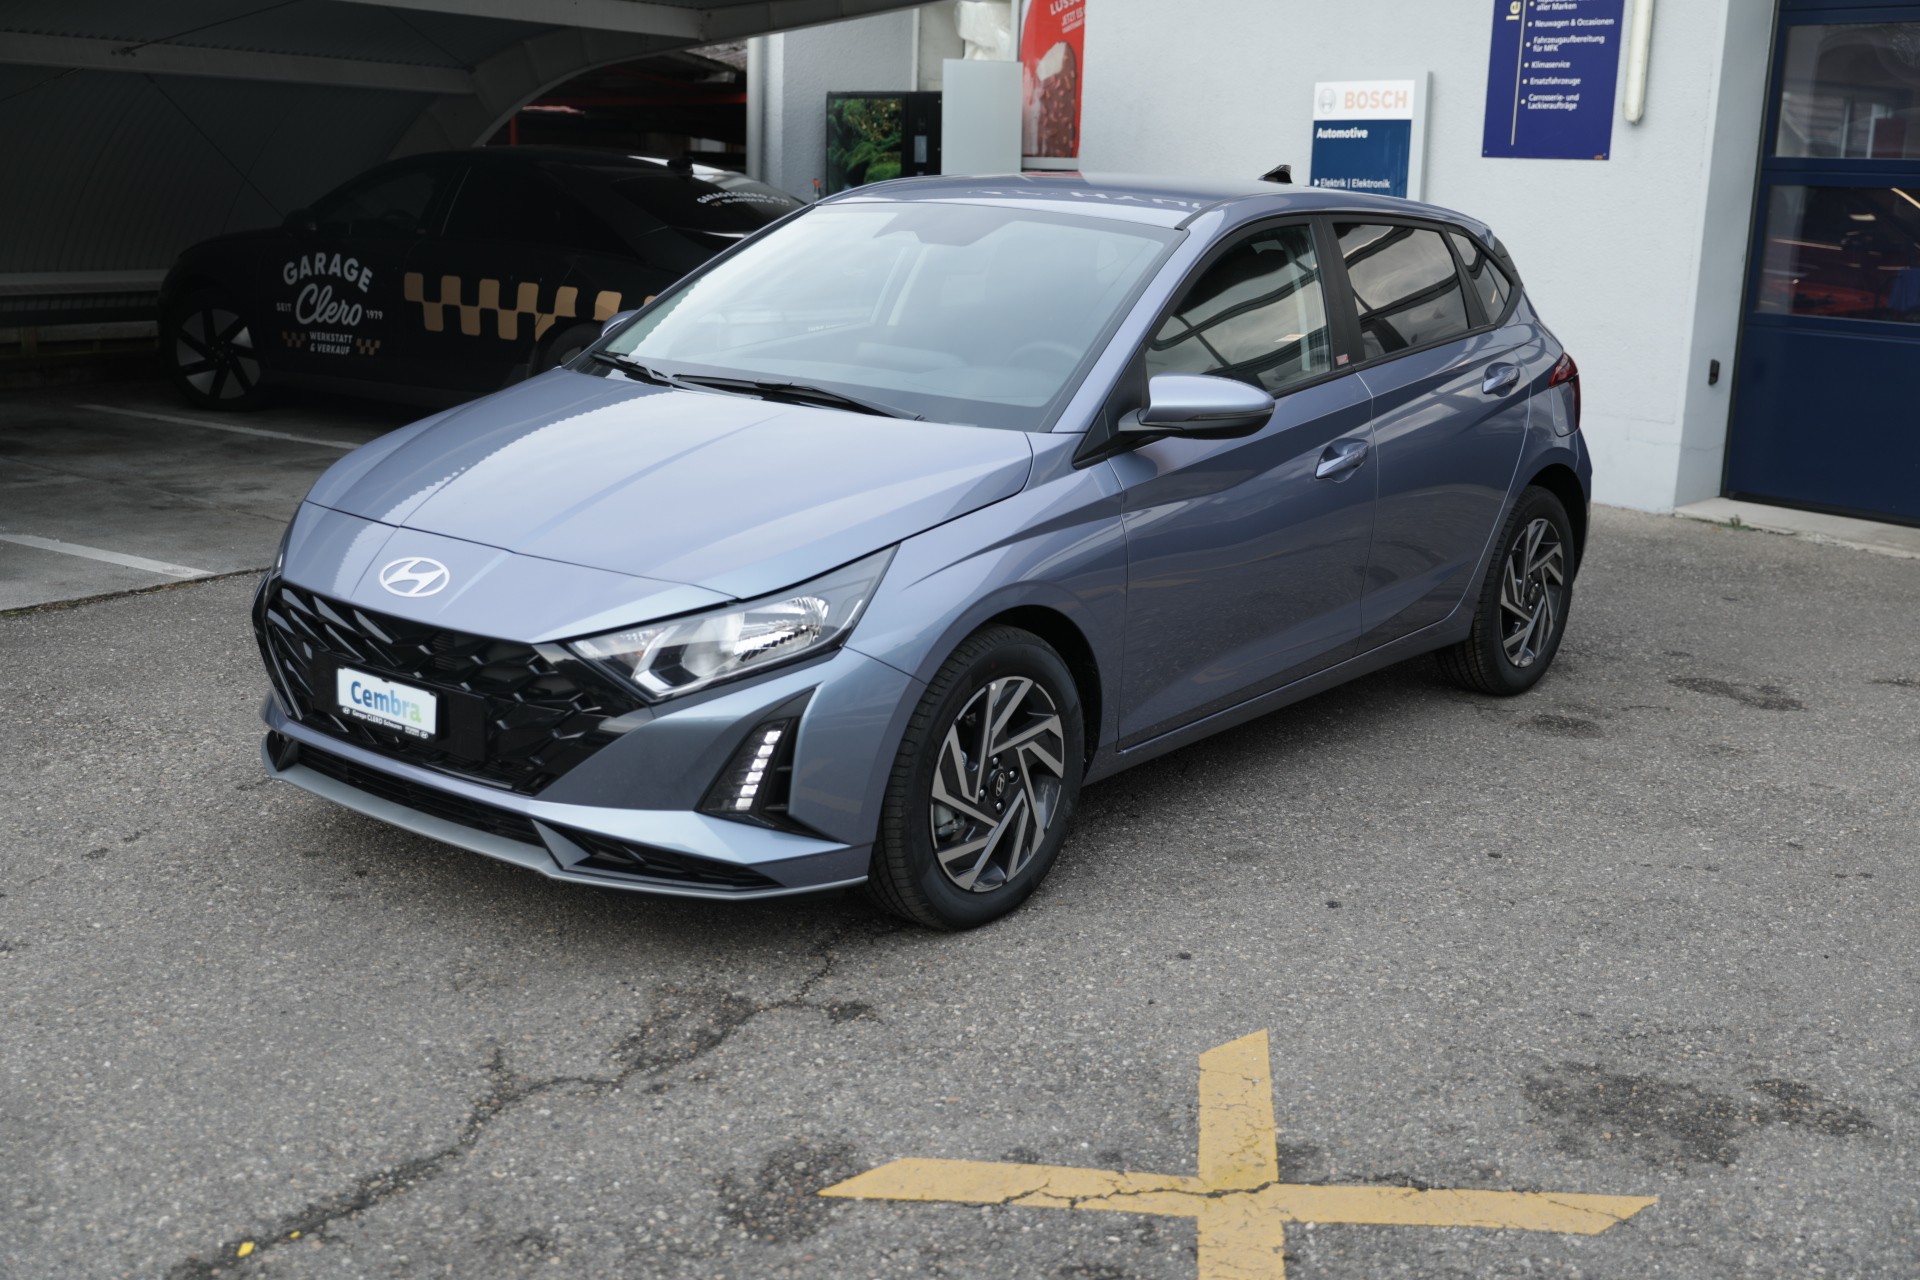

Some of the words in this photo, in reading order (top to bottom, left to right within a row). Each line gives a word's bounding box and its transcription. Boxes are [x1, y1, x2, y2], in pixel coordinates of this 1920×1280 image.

[1050, 0, 1081, 15] LUS
[1536, 3, 1551, 11] aller
[1552, 2, 1577, 10] Marken
[1535, 20, 1569, 28] Neuwagen
[1577, 18, 1614, 26] Occasionen
[1533, 35, 1605, 44] Fahrzeugaufbereitung
[1530, 77, 1581, 86] Ersatzfahrzeuge
[1344, 91, 1407, 109] BOSCH
[1566, 93, 1580, 101] und
[1528, 102, 1577, 111] Lackieraufträge
[1316, 127, 1368, 138] Automotive
[1320, 178, 1346, 188] Elektrik
[1351, 179, 1390, 188] Elektronik
[283, 252, 373, 293] GARAGE
[276, 302, 292, 312] SEIT
[296, 283, 362, 326] Clero
[366, 309, 383, 319] 1979
[309, 331, 353, 343] WERKSTATT
[310, 343, 315, 352] &
[317, 344, 351, 355] VERKAUF
[351, 681, 421, 723] Cembra
